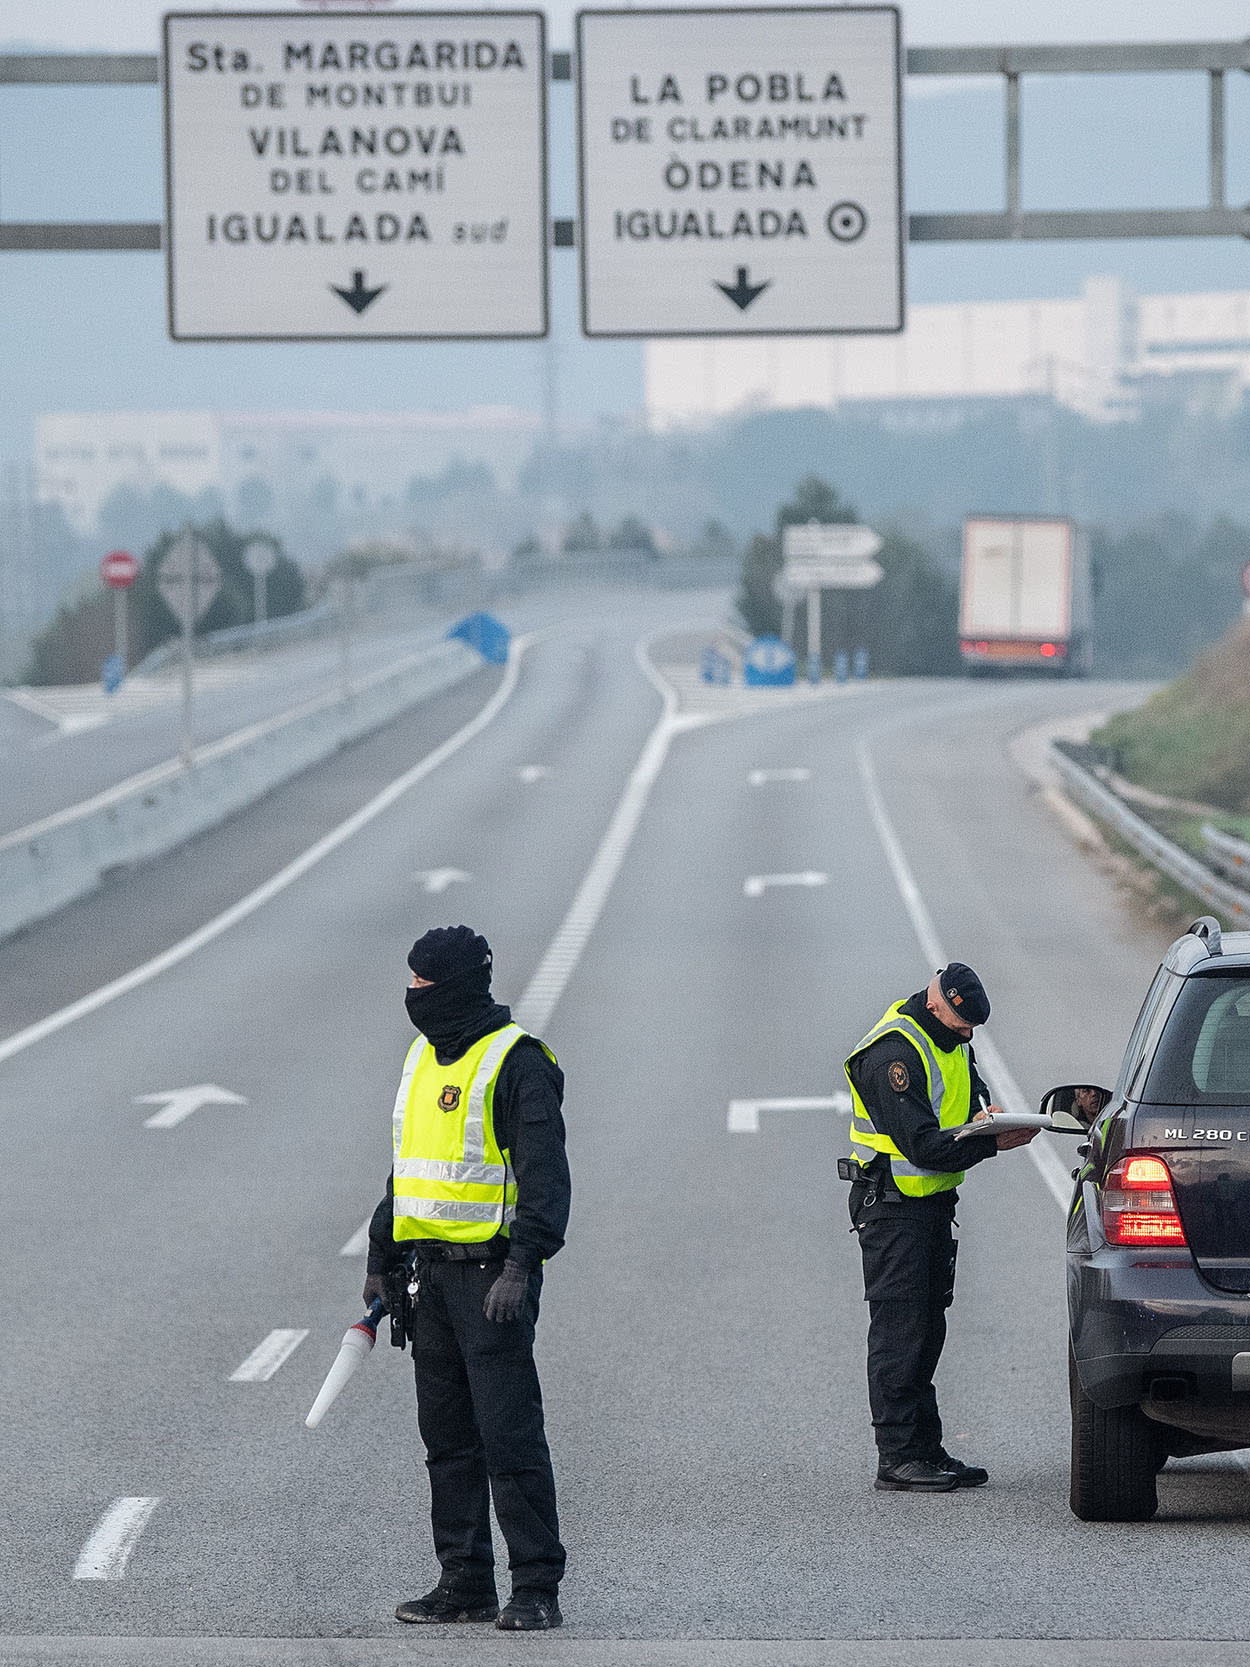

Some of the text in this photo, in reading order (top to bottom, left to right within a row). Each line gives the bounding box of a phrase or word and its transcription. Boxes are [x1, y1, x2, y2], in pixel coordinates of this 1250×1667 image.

[186, 40, 527, 73] Sta. MARGARIDA
[239, 81, 472, 110] DE MONTBUI
[630, 72, 847, 105] LA POBLA
[249, 126, 464, 158] VILANOVA
[610, 114, 868, 144] DE CLARAMUNT
[269, 163, 445, 195] DEL CAMÍ
[664, 154, 817, 191] ÒDENA
[207, 212, 509, 245] IGUALADA sud
[614, 208, 809, 241] IGUALADA
[1163, 1127, 1188, 1140] ML
[1192, 1128, 1233, 1141] 280
